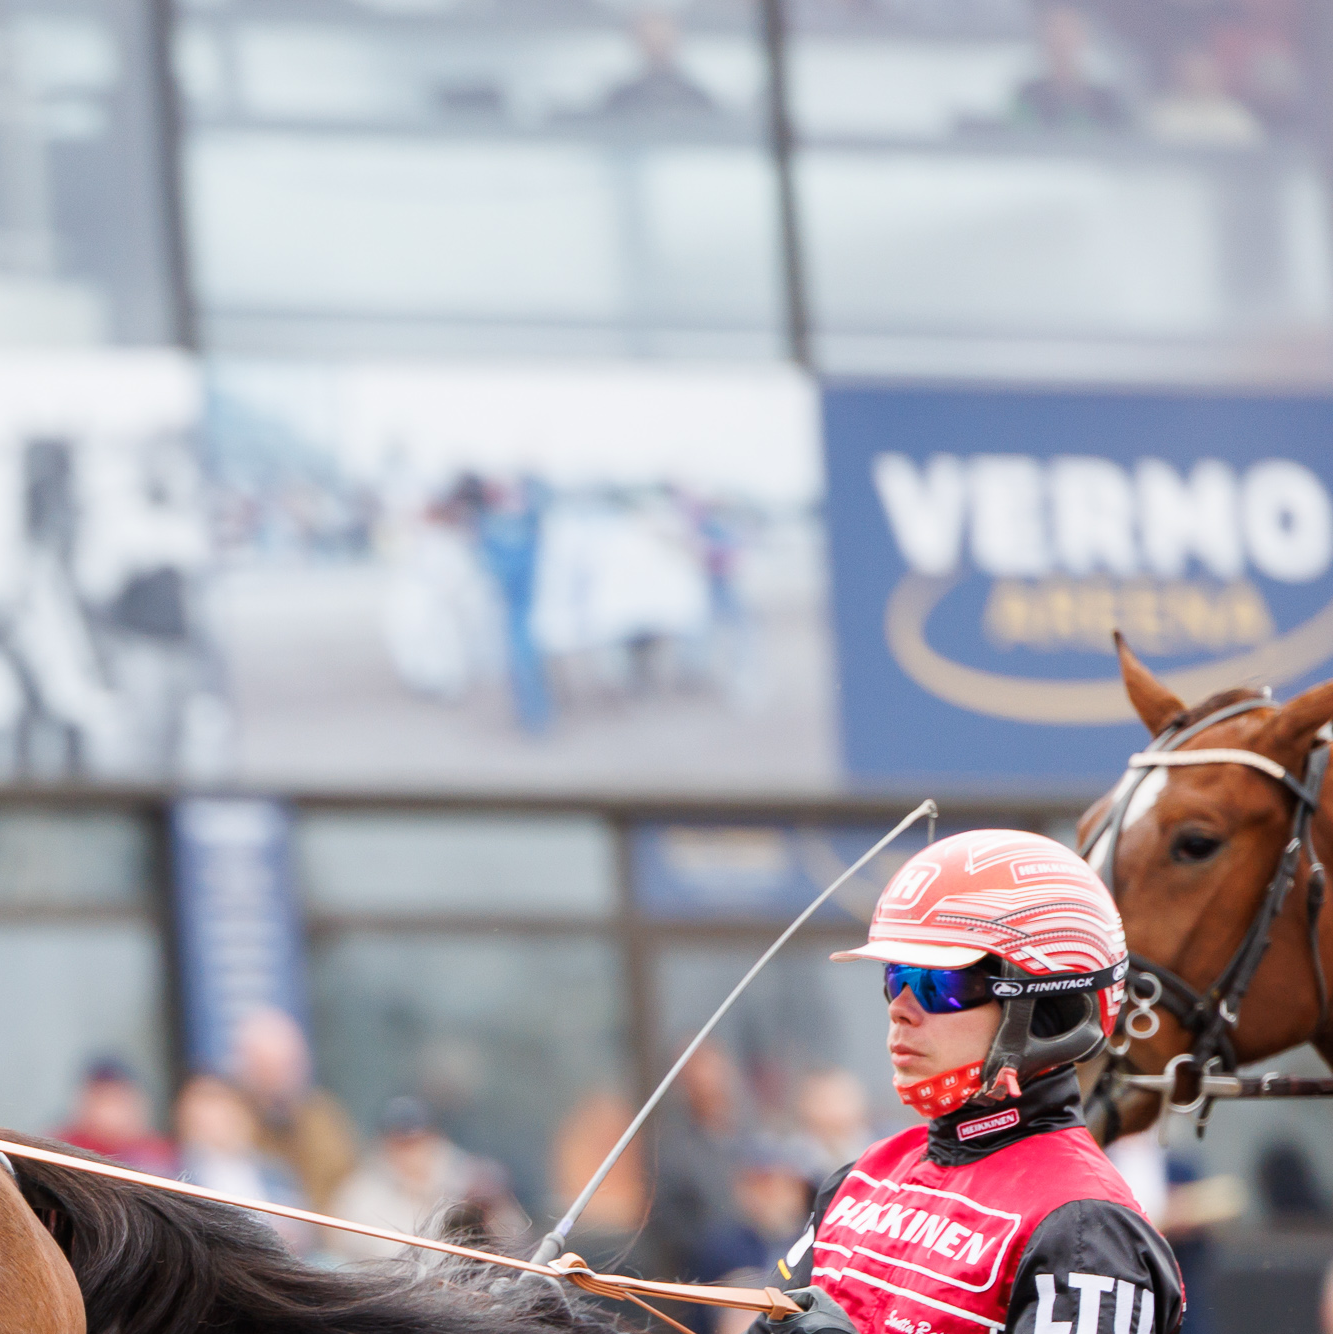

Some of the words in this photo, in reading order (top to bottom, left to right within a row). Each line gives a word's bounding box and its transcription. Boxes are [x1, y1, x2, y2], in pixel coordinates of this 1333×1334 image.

[872, 452, 1333, 585] VERMO
[1026, 976, 1095, 994] FINNTACK
[961, 1113, 1016, 1136] HEIKKINEN
